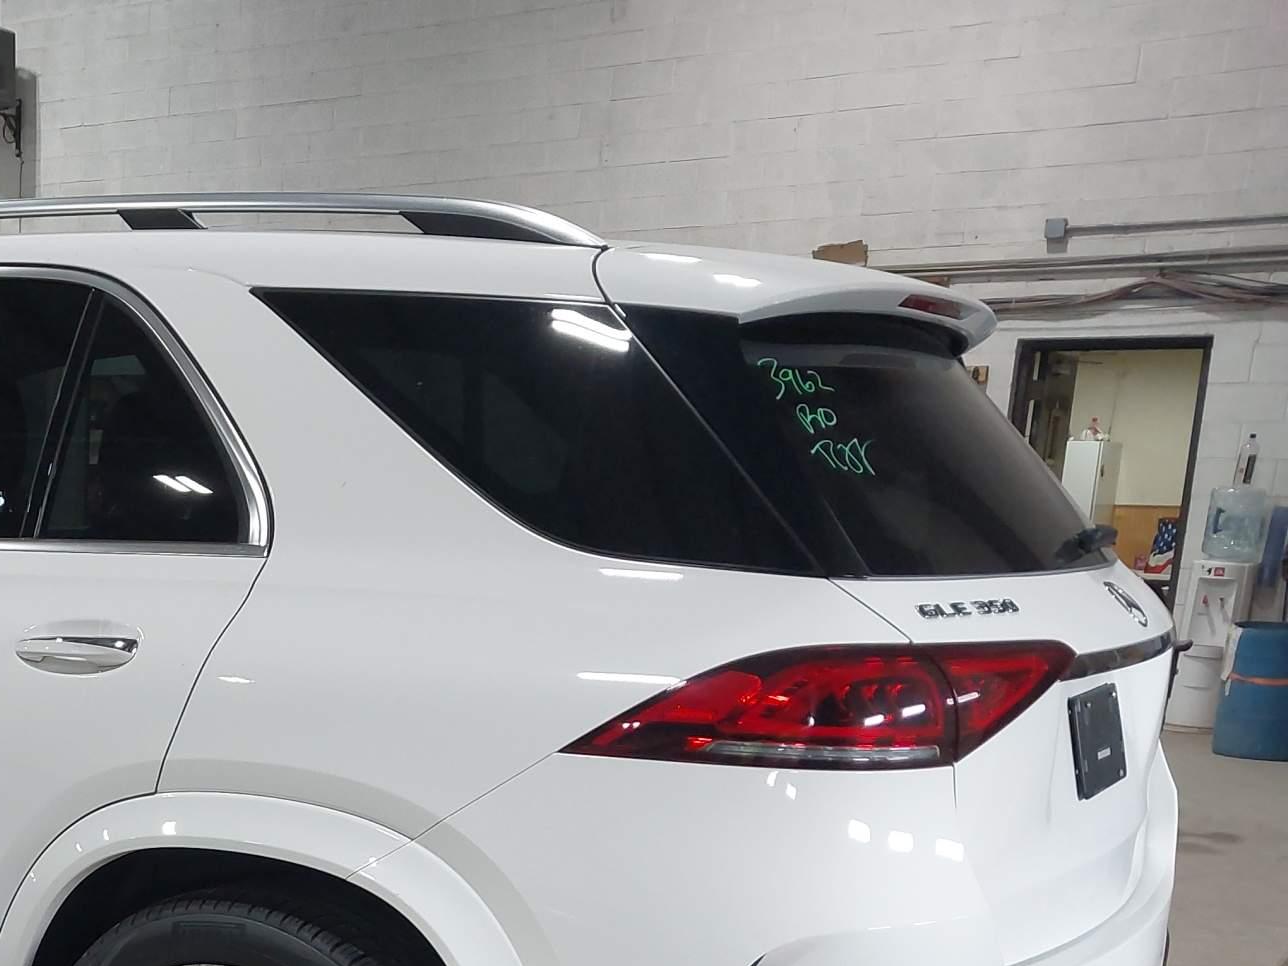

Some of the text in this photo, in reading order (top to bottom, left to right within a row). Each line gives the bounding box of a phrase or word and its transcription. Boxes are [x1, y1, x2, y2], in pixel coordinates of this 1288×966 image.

[757, 357, 835, 400] 3962
[916, 598, 1020, 619] GLE 350
